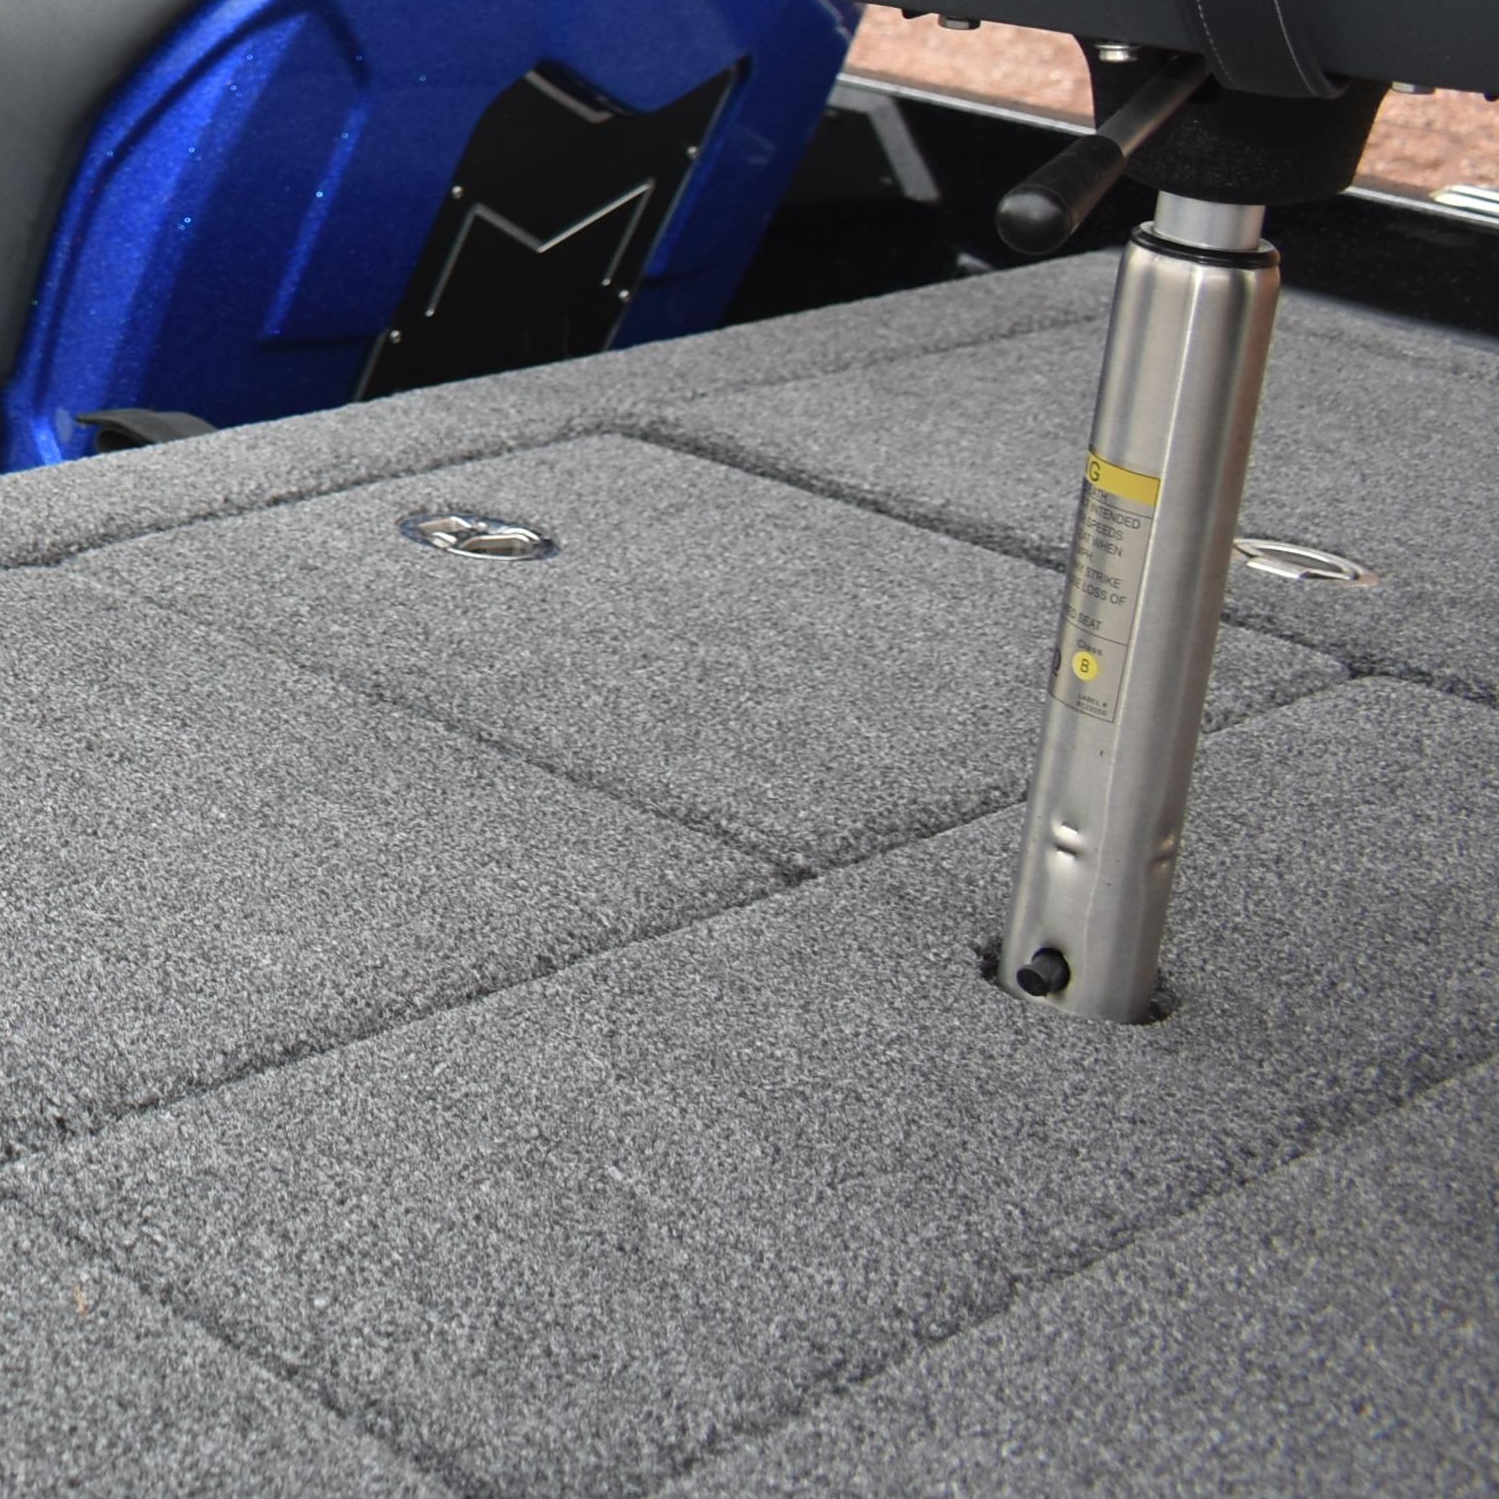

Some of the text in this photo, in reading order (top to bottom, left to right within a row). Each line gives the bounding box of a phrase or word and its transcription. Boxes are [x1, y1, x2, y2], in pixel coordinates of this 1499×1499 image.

[1085, 516, 1124, 541] SPEEDS
[1090, 504, 1141, 530] INTENDED
[1092, 536, 1123, 558] WHEN
[1085, 566, 1123, 590] STRIKE
[1081, 582, 1108, 602] LOSS
[1109, 592, 1128, 607] OF
[1078, 612, 1103, 632] SEAT
[1080, 658, 1091, 674] B
